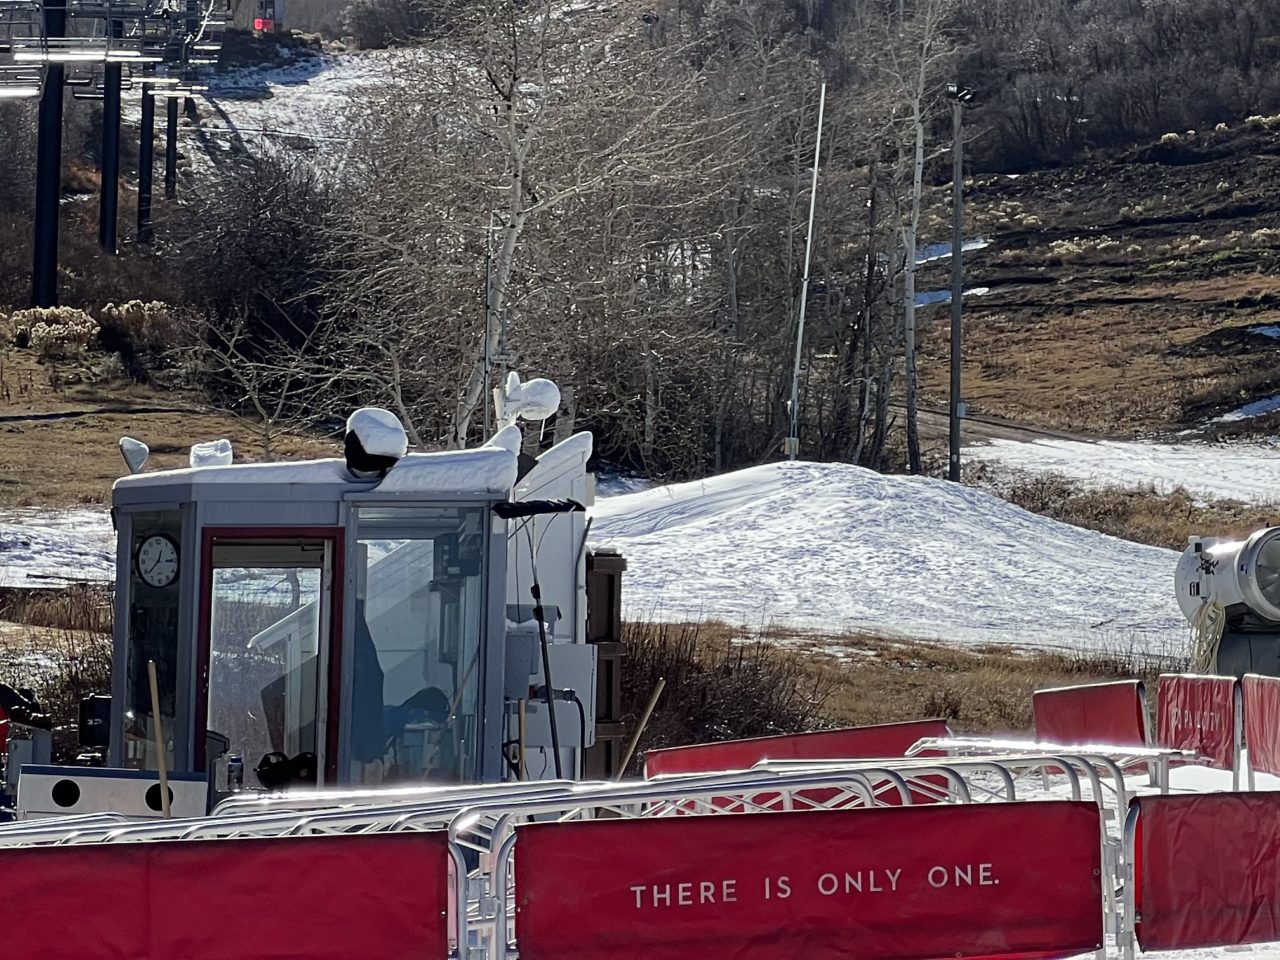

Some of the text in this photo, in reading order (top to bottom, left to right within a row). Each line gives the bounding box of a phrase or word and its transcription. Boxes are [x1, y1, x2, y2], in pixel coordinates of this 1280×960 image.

[629, 863, 1001, 909] THERE IS ONLY ONE.
